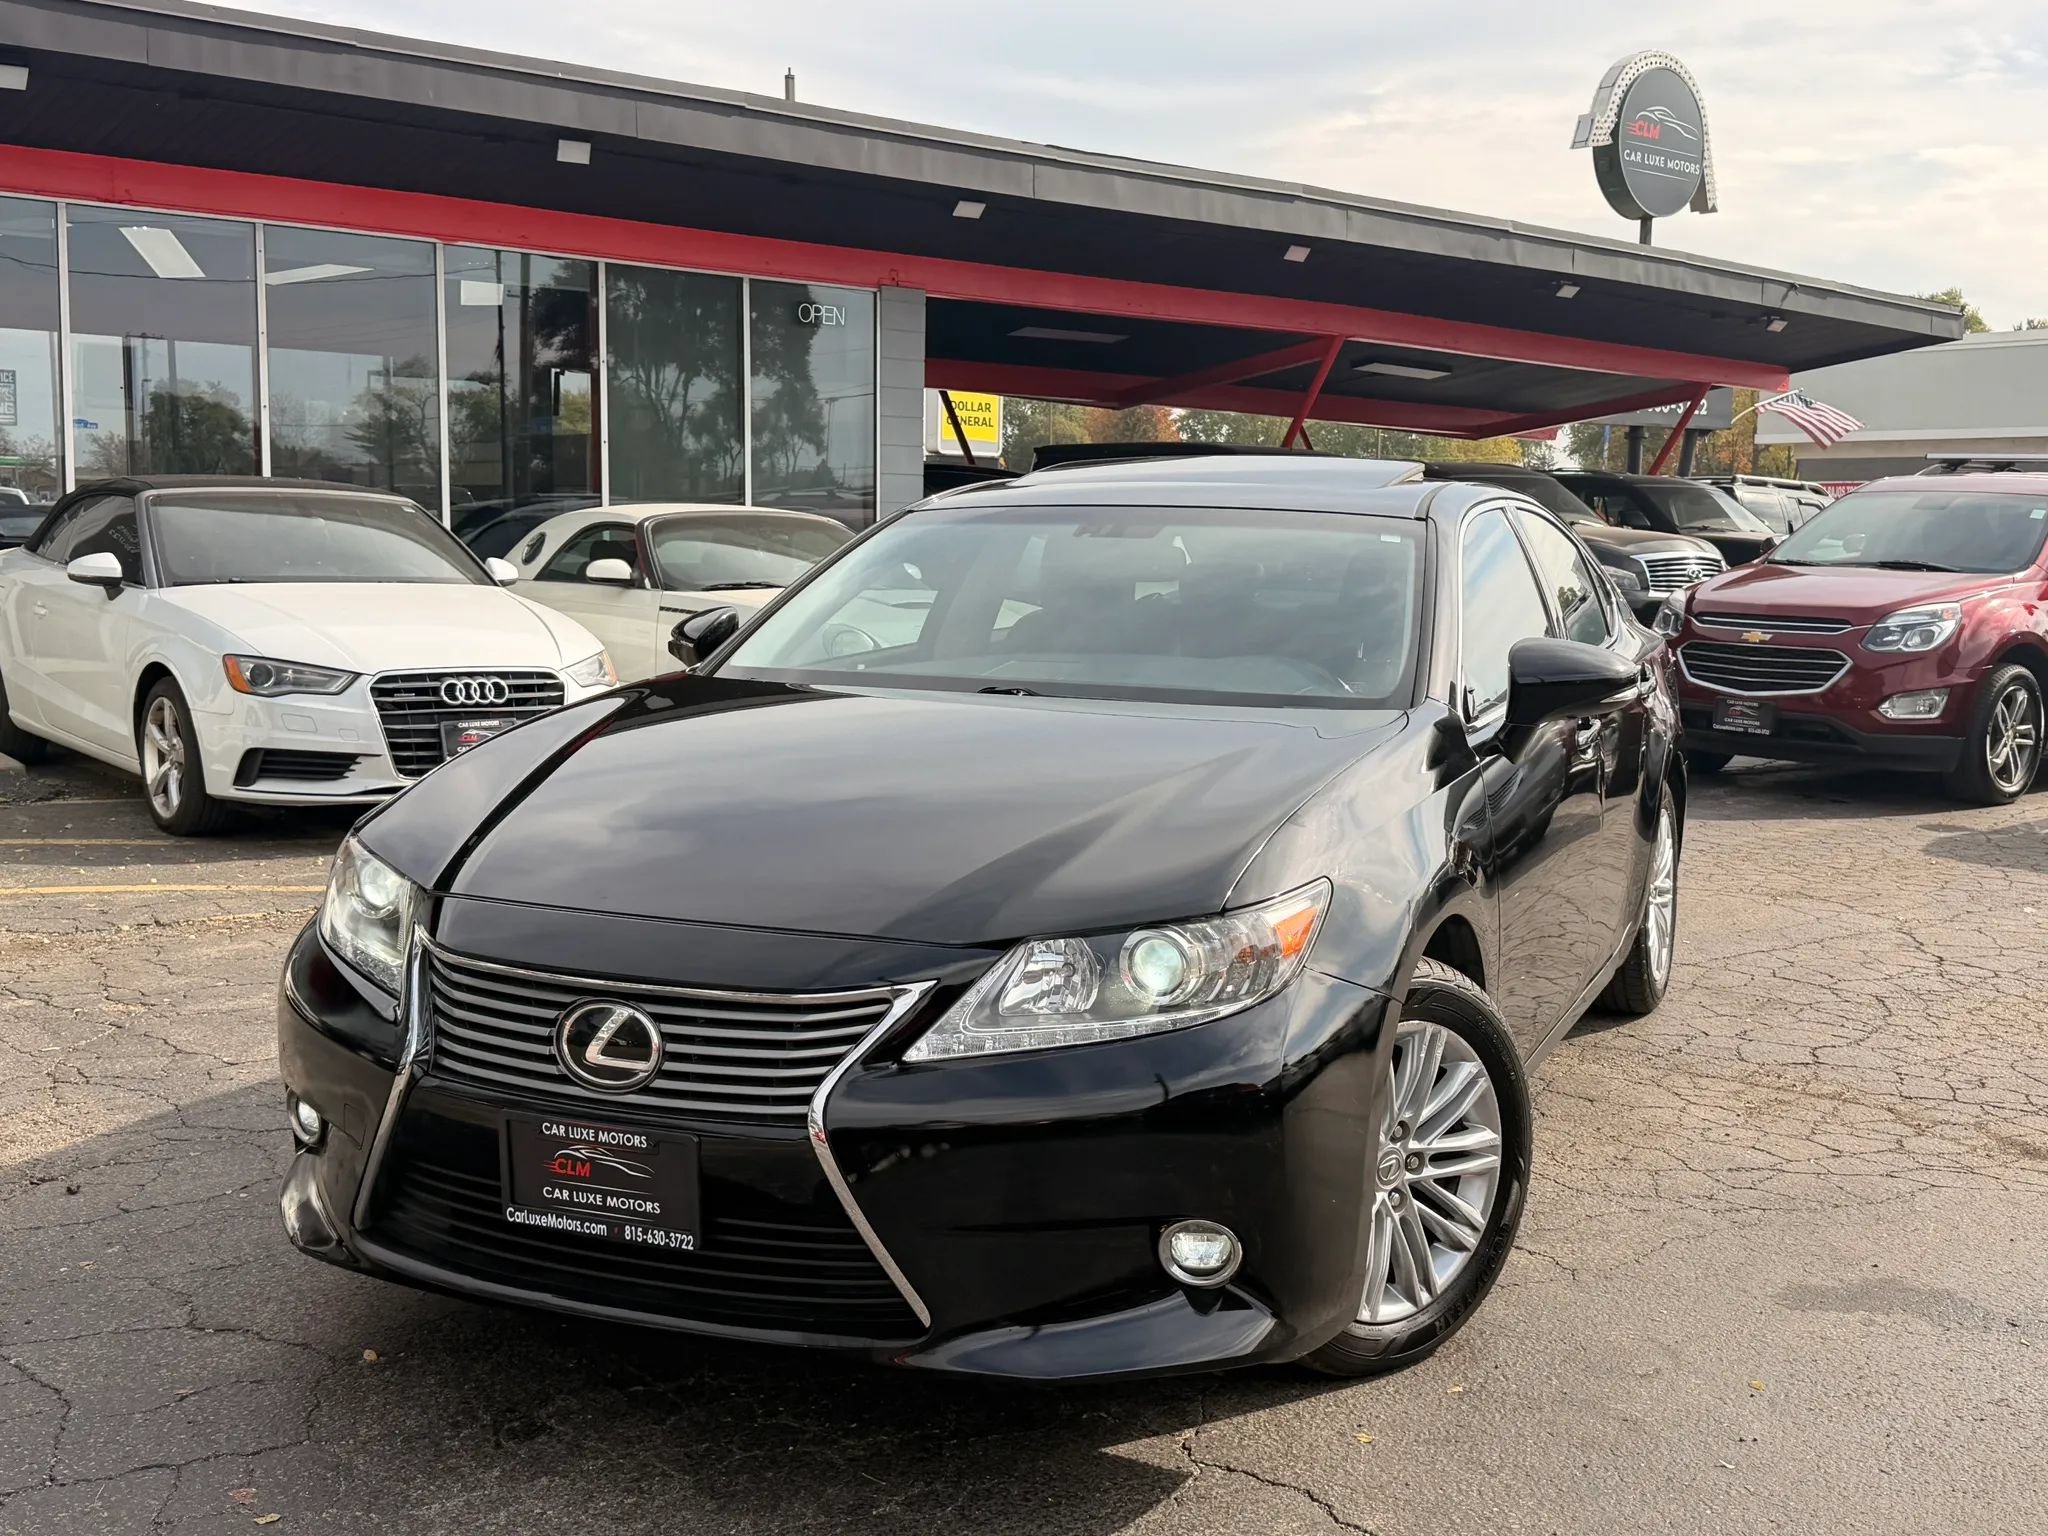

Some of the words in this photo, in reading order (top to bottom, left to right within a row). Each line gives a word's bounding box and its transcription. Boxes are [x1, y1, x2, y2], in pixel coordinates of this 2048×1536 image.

[1624, 149, 1642, 162] CAR
[1644, 153, 1665, 167] LUXE
[1667, 158, 1700, 175] MOTORS
[798, 303, 845, 326] OPEN
[951, 400, 992, 413] DOLLAR
[946, 415, 994, 428] GNERAL
[542, 1122, 566, 1138] CAR
[568, 1126, 595, 1142] LUXE
[598, 1130, 647, 1149] MOTORS
[553, 1158, 592, 1177] CLM
[543, 1186, 570, 1201] CAR
[573, 1191, 603, 1206] LUXE
[606, 1195, 661, 1214] MOTORS
[506, 1207, 608, 1237] CarLuxeMotors.com
[624, 1225, 694, 1250] 815-630-3722
